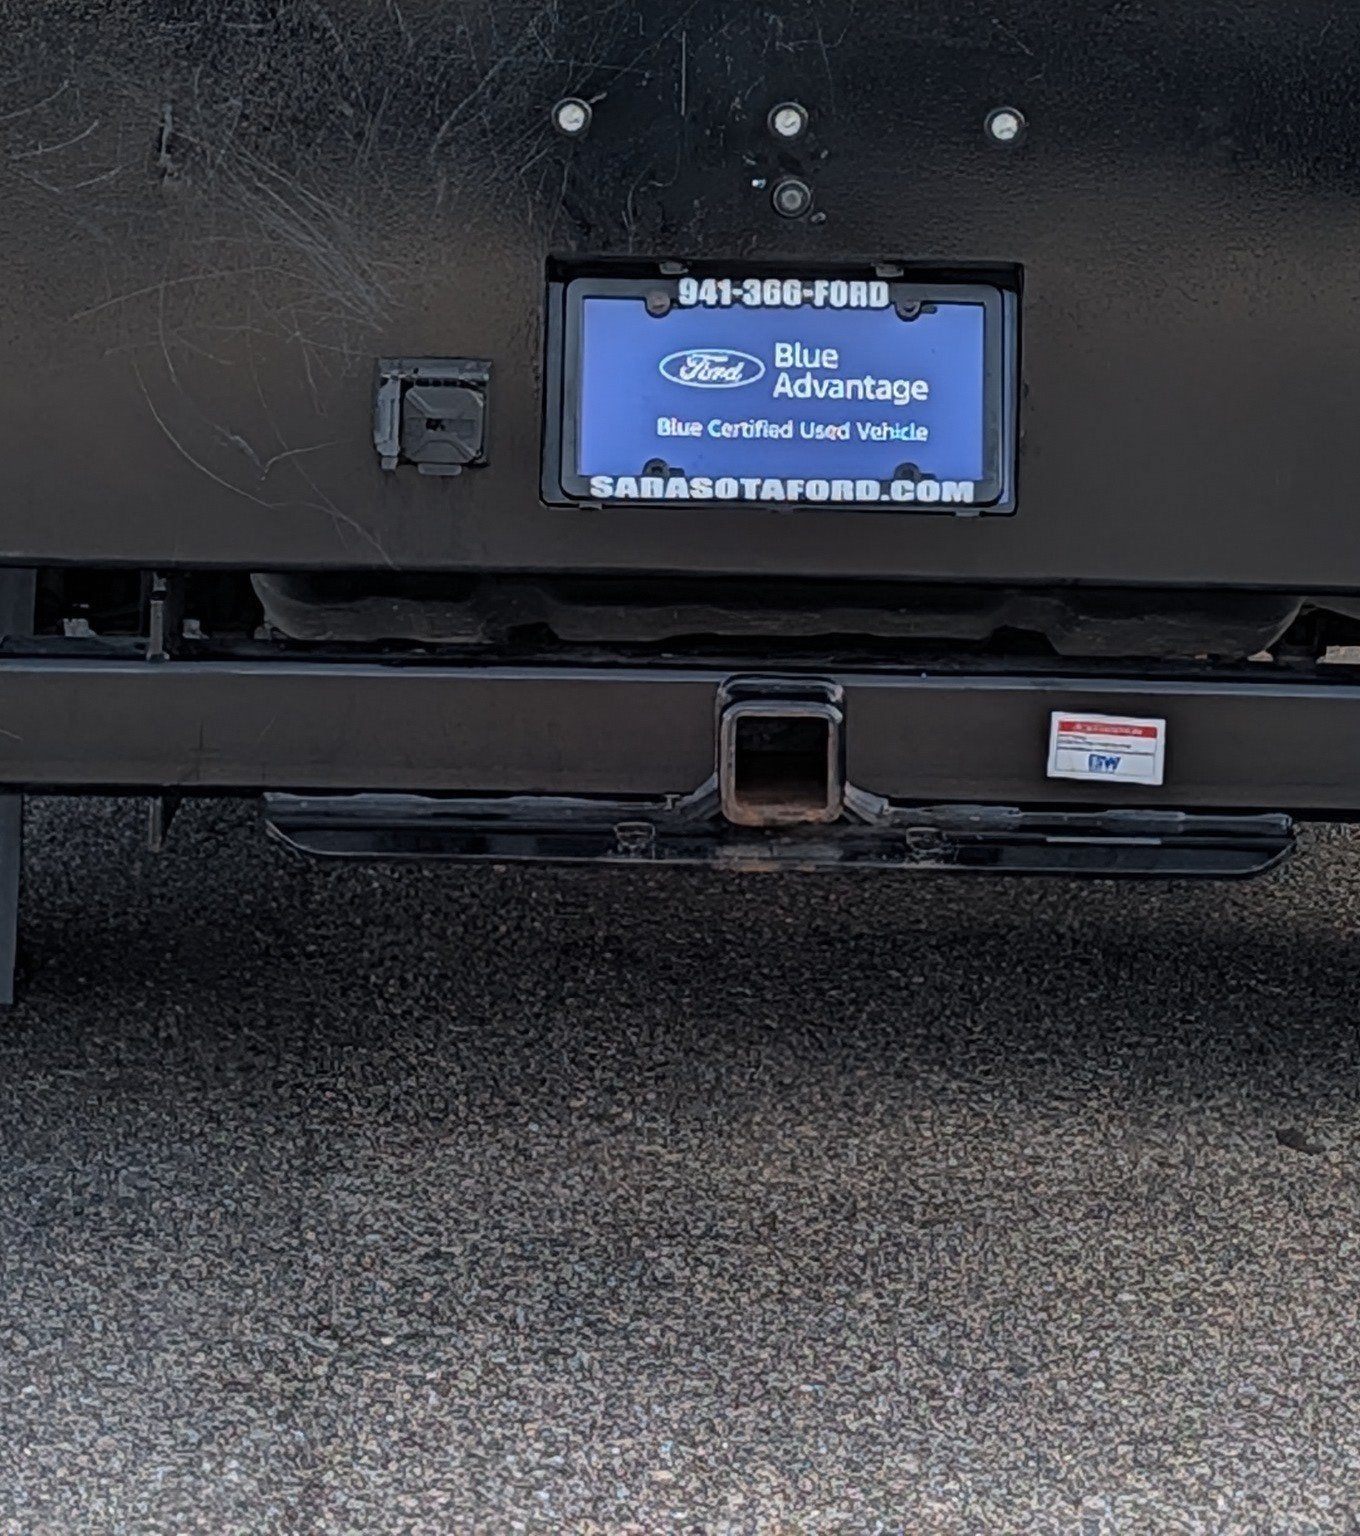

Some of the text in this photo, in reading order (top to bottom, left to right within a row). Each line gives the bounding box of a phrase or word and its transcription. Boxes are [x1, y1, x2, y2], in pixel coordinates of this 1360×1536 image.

[678, 278, 891, 309] 941-366-FORD
[679, 353, 745, 383] Ford
[774, 342, 840, 370] Blue
[773, 372, 930, 406] Advantage
[656, 417, 930, 443] Blue Certified Used Vehicle
[590, 476, 975, 504] SARASOTAFORD.COM
